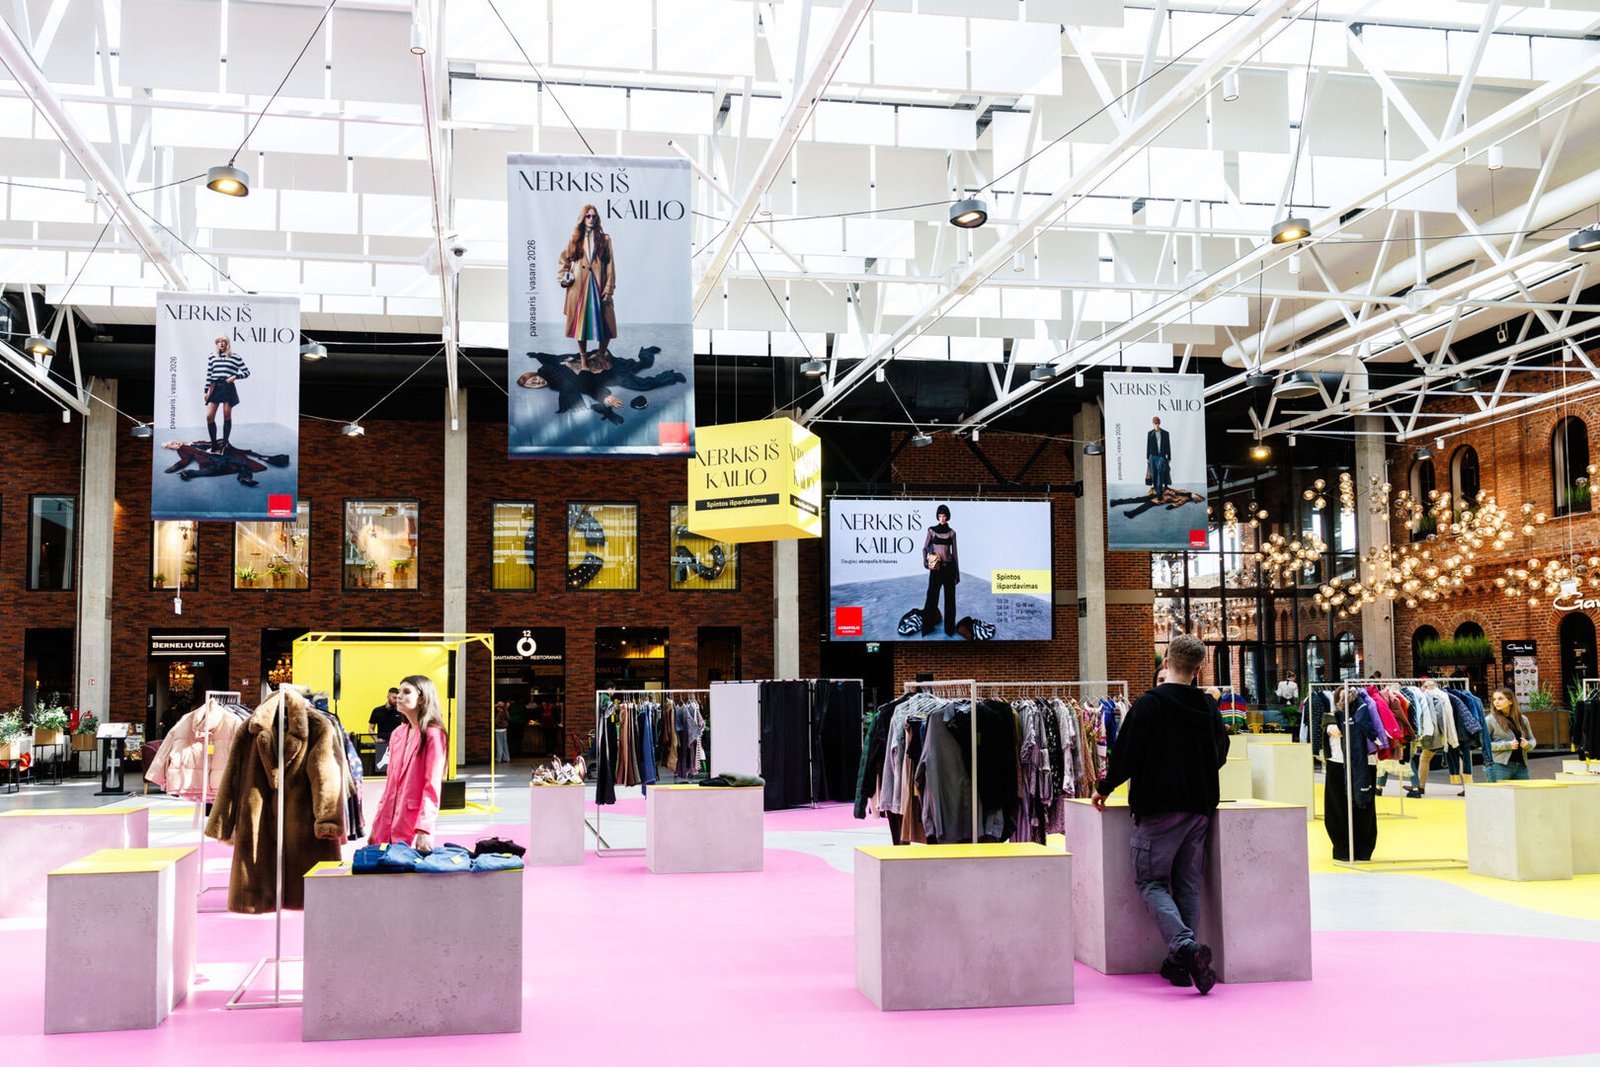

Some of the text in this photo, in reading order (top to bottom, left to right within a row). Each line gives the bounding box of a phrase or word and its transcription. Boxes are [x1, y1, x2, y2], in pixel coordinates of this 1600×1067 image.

[518, 168, 630, 194] NERKIS IŠ
[607, 198, 685, 221] KAILIO
[527, 239, 538, 337] pavasaris vasara 2026
[165, 303, 252, 322] NERKIS IŠ
[233, 326, 295, 344] KAILIO
[1110, 381, 1171, 396] NERKIS IŠ
[169, 398, 177, 430] pavasaris
[1157, 399, 1201, 412] KAILIO
[695, 444, 759, 468] NERKIS
[764, 438, 780, 461] IŠ
[706, 467, 767, 489] KAILIO
[706, 497, 767, 509] Spintos išpardavimas
[840, 510, 922, 532] NERKIS IŠ
[856, 536, 914, 555] KAILIO
[996, 573, 1021, 581] Spintos
[996, 582, 1039, 590] išpardavimas
